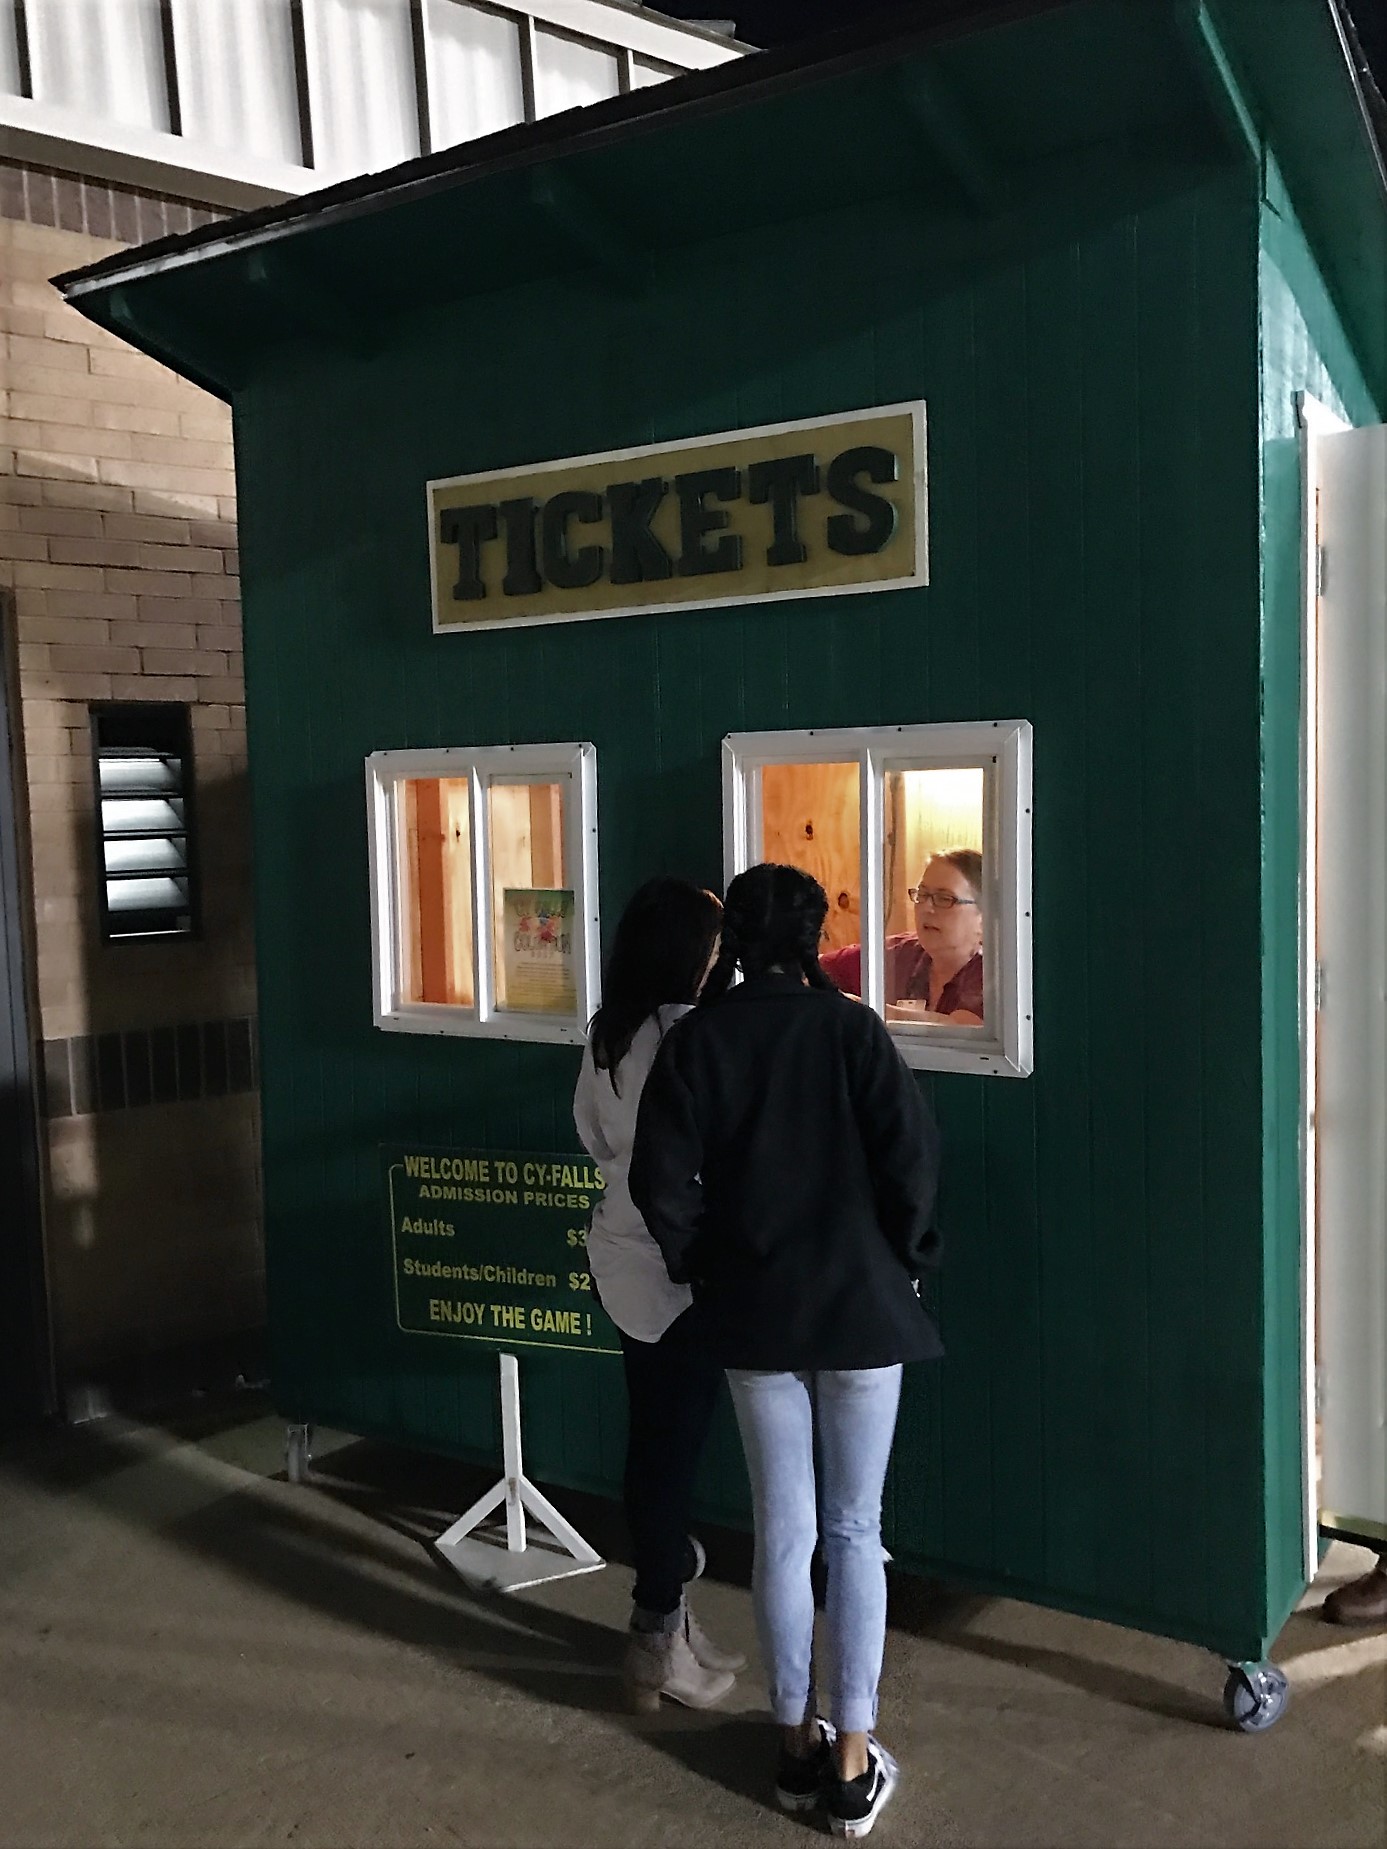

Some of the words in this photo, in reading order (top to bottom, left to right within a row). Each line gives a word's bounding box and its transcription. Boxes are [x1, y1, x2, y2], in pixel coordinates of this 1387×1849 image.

[440, 446, 899, 600] TICKETS
[404, 1155, 490, 1183] WELCOME
[494, 1161, 518, 1185] TO
[523, 1164, 606, 1190] CY-FALLS
[419, 1184, 518, 1205] ADMISSION
[523, 1191, 590, 1209] PRICES
[401, 1217, 455, 1237] Adults
[403, 1258, 557, 1288] Students/Children
[569, 1272, 591, 1292] $2
[429, 1299, 486, 1325] ENJOY
[491, 1305, 526, 1329] THE
[531, 1309, 582, 1333] GAME
